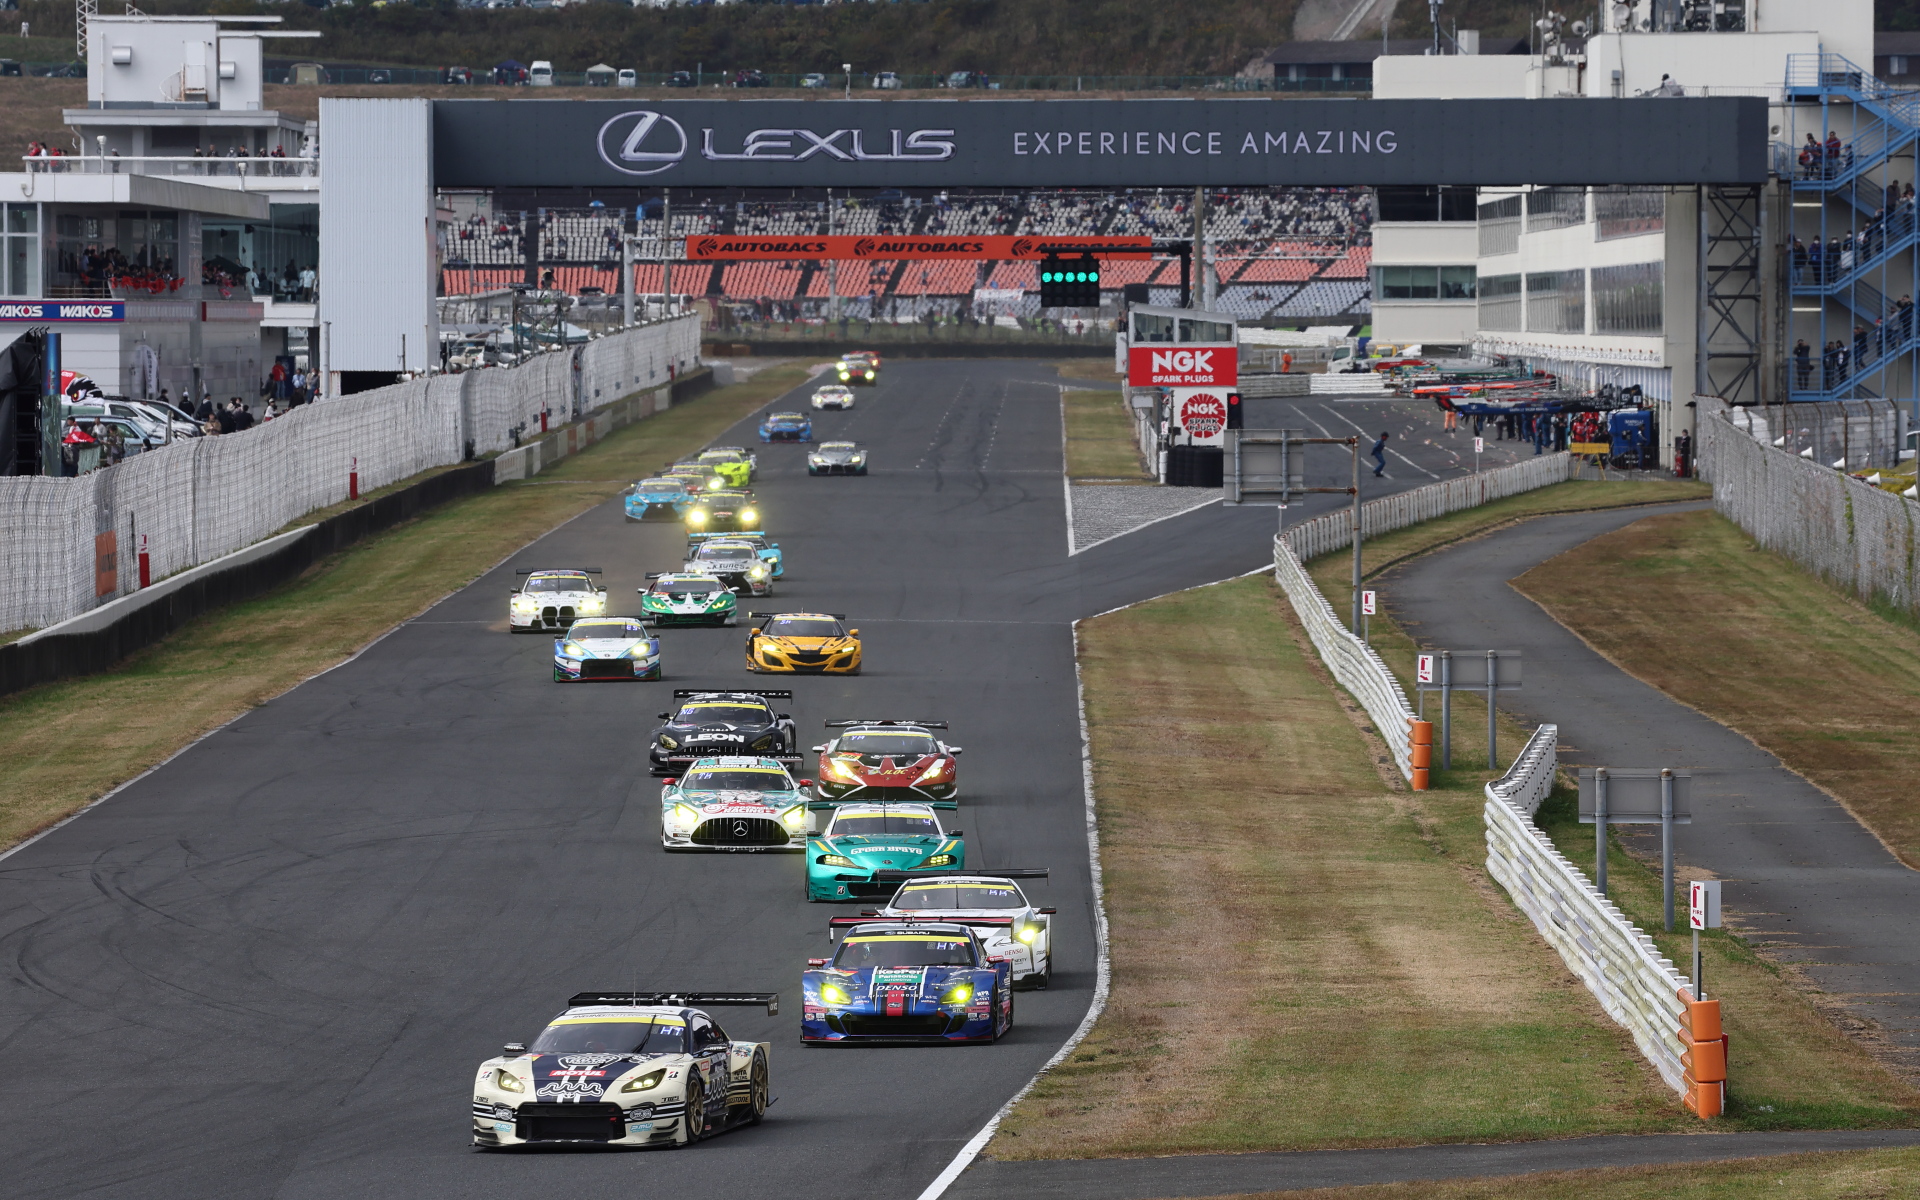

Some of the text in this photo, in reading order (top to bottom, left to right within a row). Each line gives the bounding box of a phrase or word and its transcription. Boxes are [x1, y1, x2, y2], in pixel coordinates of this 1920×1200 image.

[700, 127, 1399, 162] LEXUS EXPERIENCE AMAZING
[719, 242, 827, 253] AUTOBACS
[876, 242, 984, 253] AUTOBACS
[1152, 350, 1214, 373] NGK
[1152, 375, 1214, 383] SPARK PLUGS
[1187, 403, 1219, 415] NGK
[1188, 417, 1218, 425] SPARK
[1188, 424, 1219, 432] PLUGS
[684, 733, 745, 743] LEON
[936, 942, 956, 951] HY
[1004, 948, 1024, 956] DENSO
[660, 1026, 684, 1036] HT
